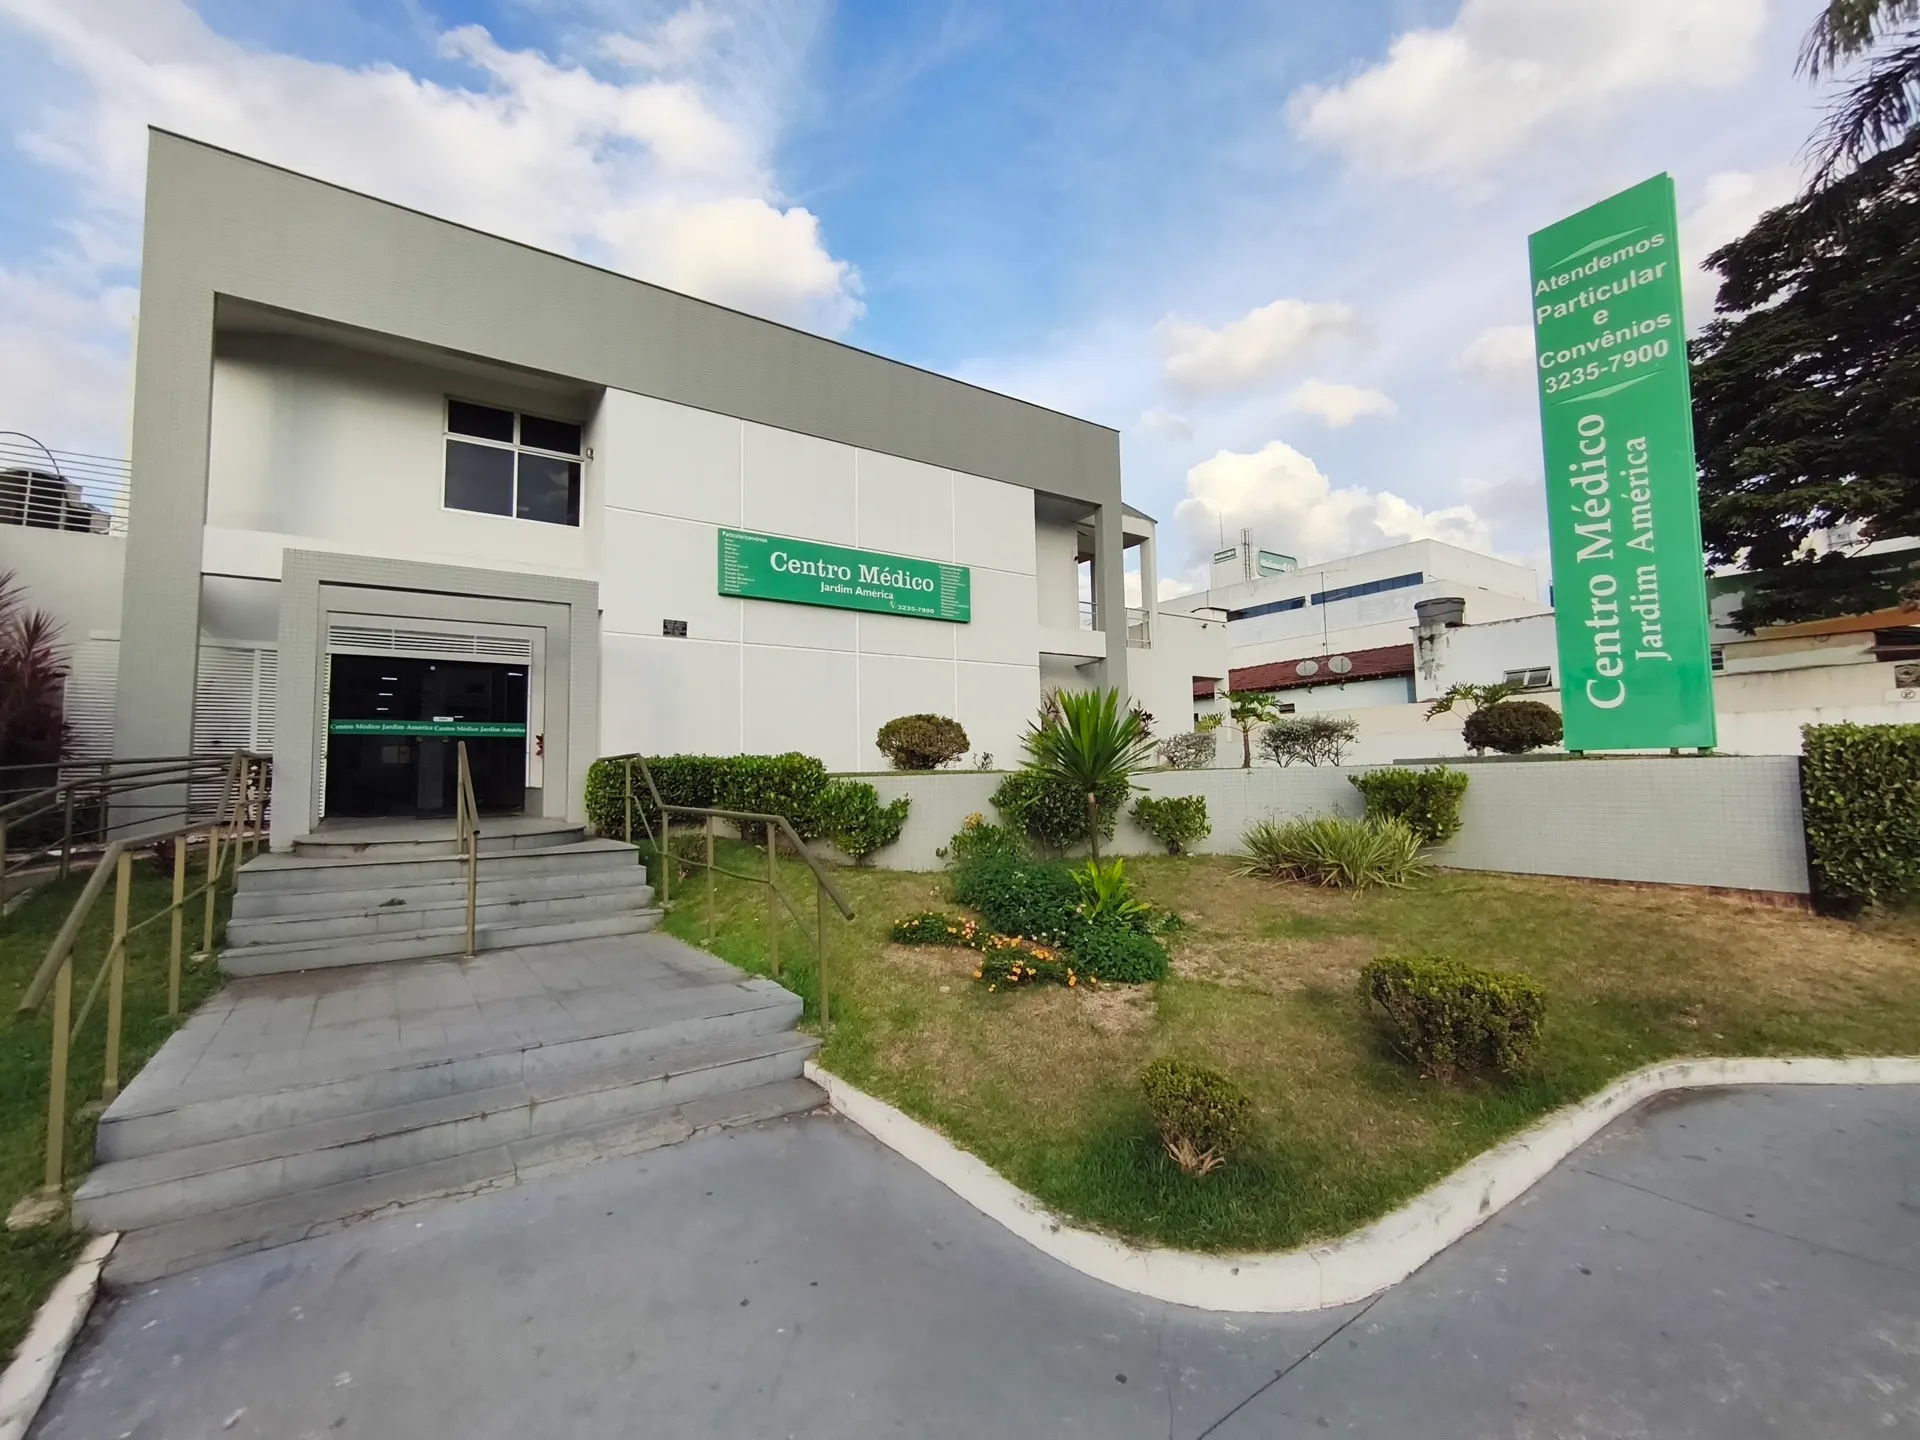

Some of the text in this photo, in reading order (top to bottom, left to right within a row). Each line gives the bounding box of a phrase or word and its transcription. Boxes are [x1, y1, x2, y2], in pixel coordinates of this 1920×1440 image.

[1535, 233, 1665, 297] Atendemos
[1536, 261, 1667, 325] Particular
[1593, 310, 1609, 325] e
[1539, 313, 1672, 369] Convênios
[1545, 339, 1669, 393] 3235-7900
[770, 551, 851, 581] Centro
[858, 563, 935, 592] Médico
[1569, 414, 1626, 709] Centro Médico
[1620, 435, 1672, 661] Jardim América
[820, 581, 894, 600] Jardim América
[897, 604, 935, 614] 3235-7900
